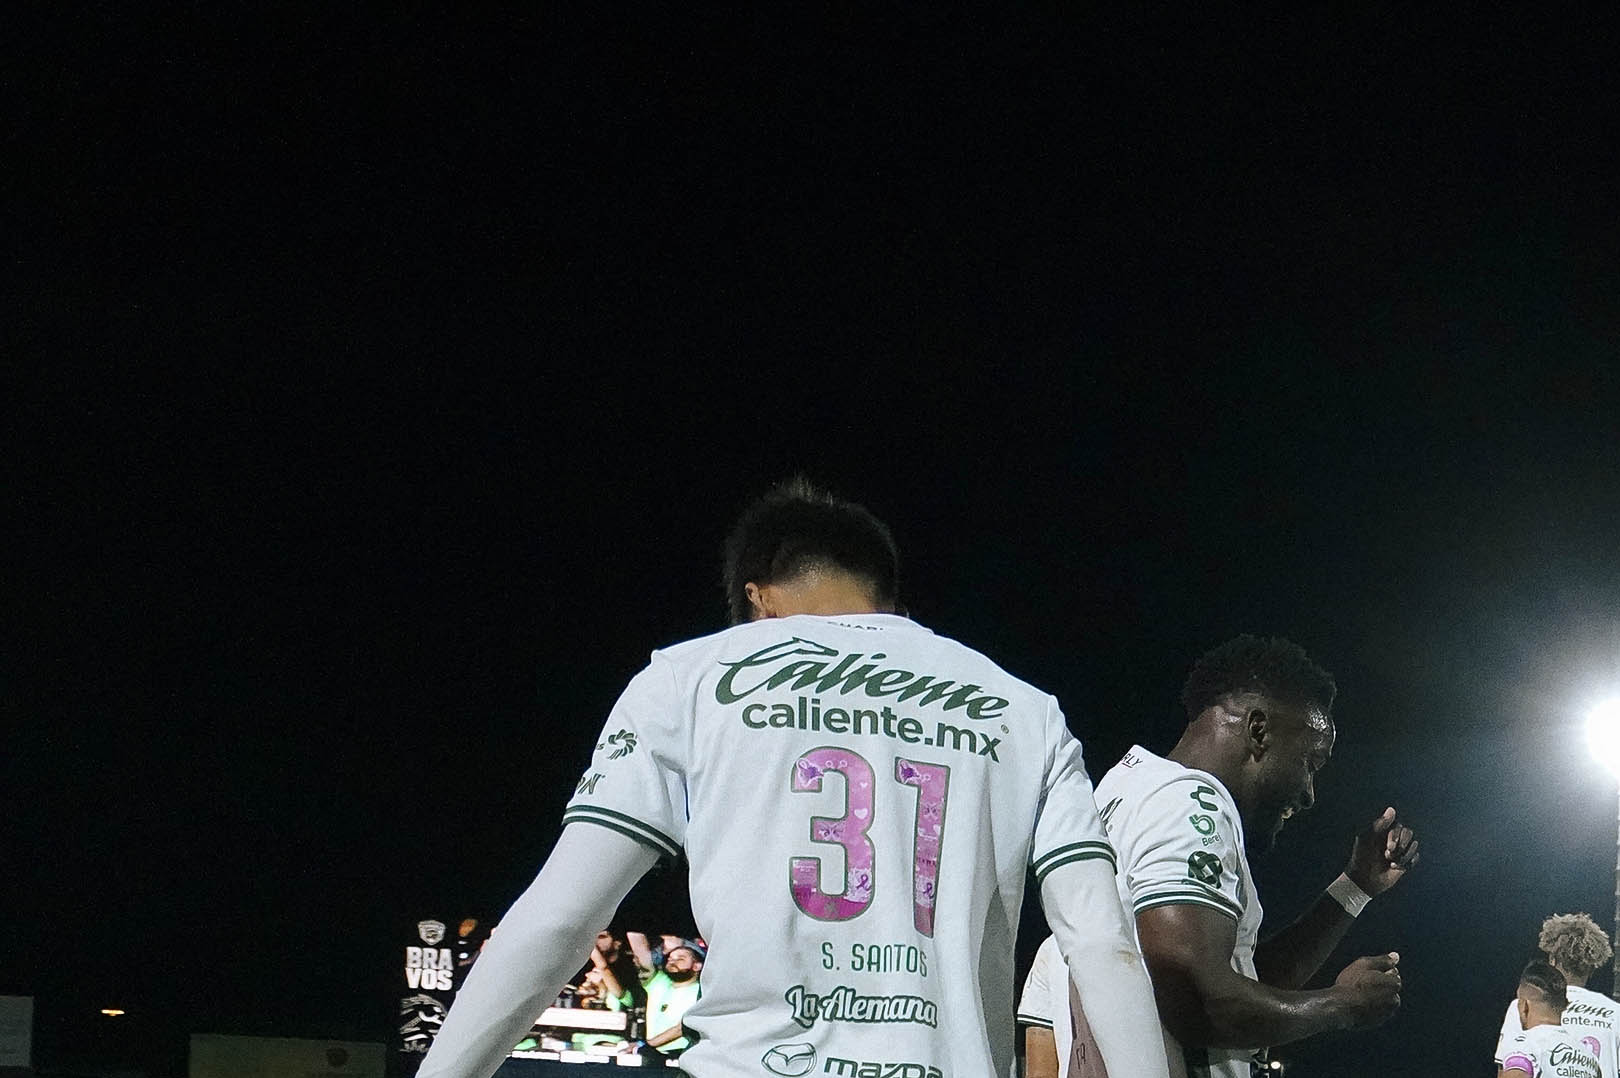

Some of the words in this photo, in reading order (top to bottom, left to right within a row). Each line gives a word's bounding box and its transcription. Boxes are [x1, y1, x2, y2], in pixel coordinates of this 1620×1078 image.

[714, 636, 1010, 705] Caliente
[741, 695, 1002, 763] caliente.mx
[788, 745, 951, 939] 31
[404, 966, 454, 991] VOS
[405, 945, 454, 971] BRA
[820, 941, 841, 971] S.
[850, 943, 929, 979] SANTOS
[784, 984, 820, 1030] La
[818, 985, 939, 1030] Alemana
[1561, 1015, 1613, 1031] ente.mx
